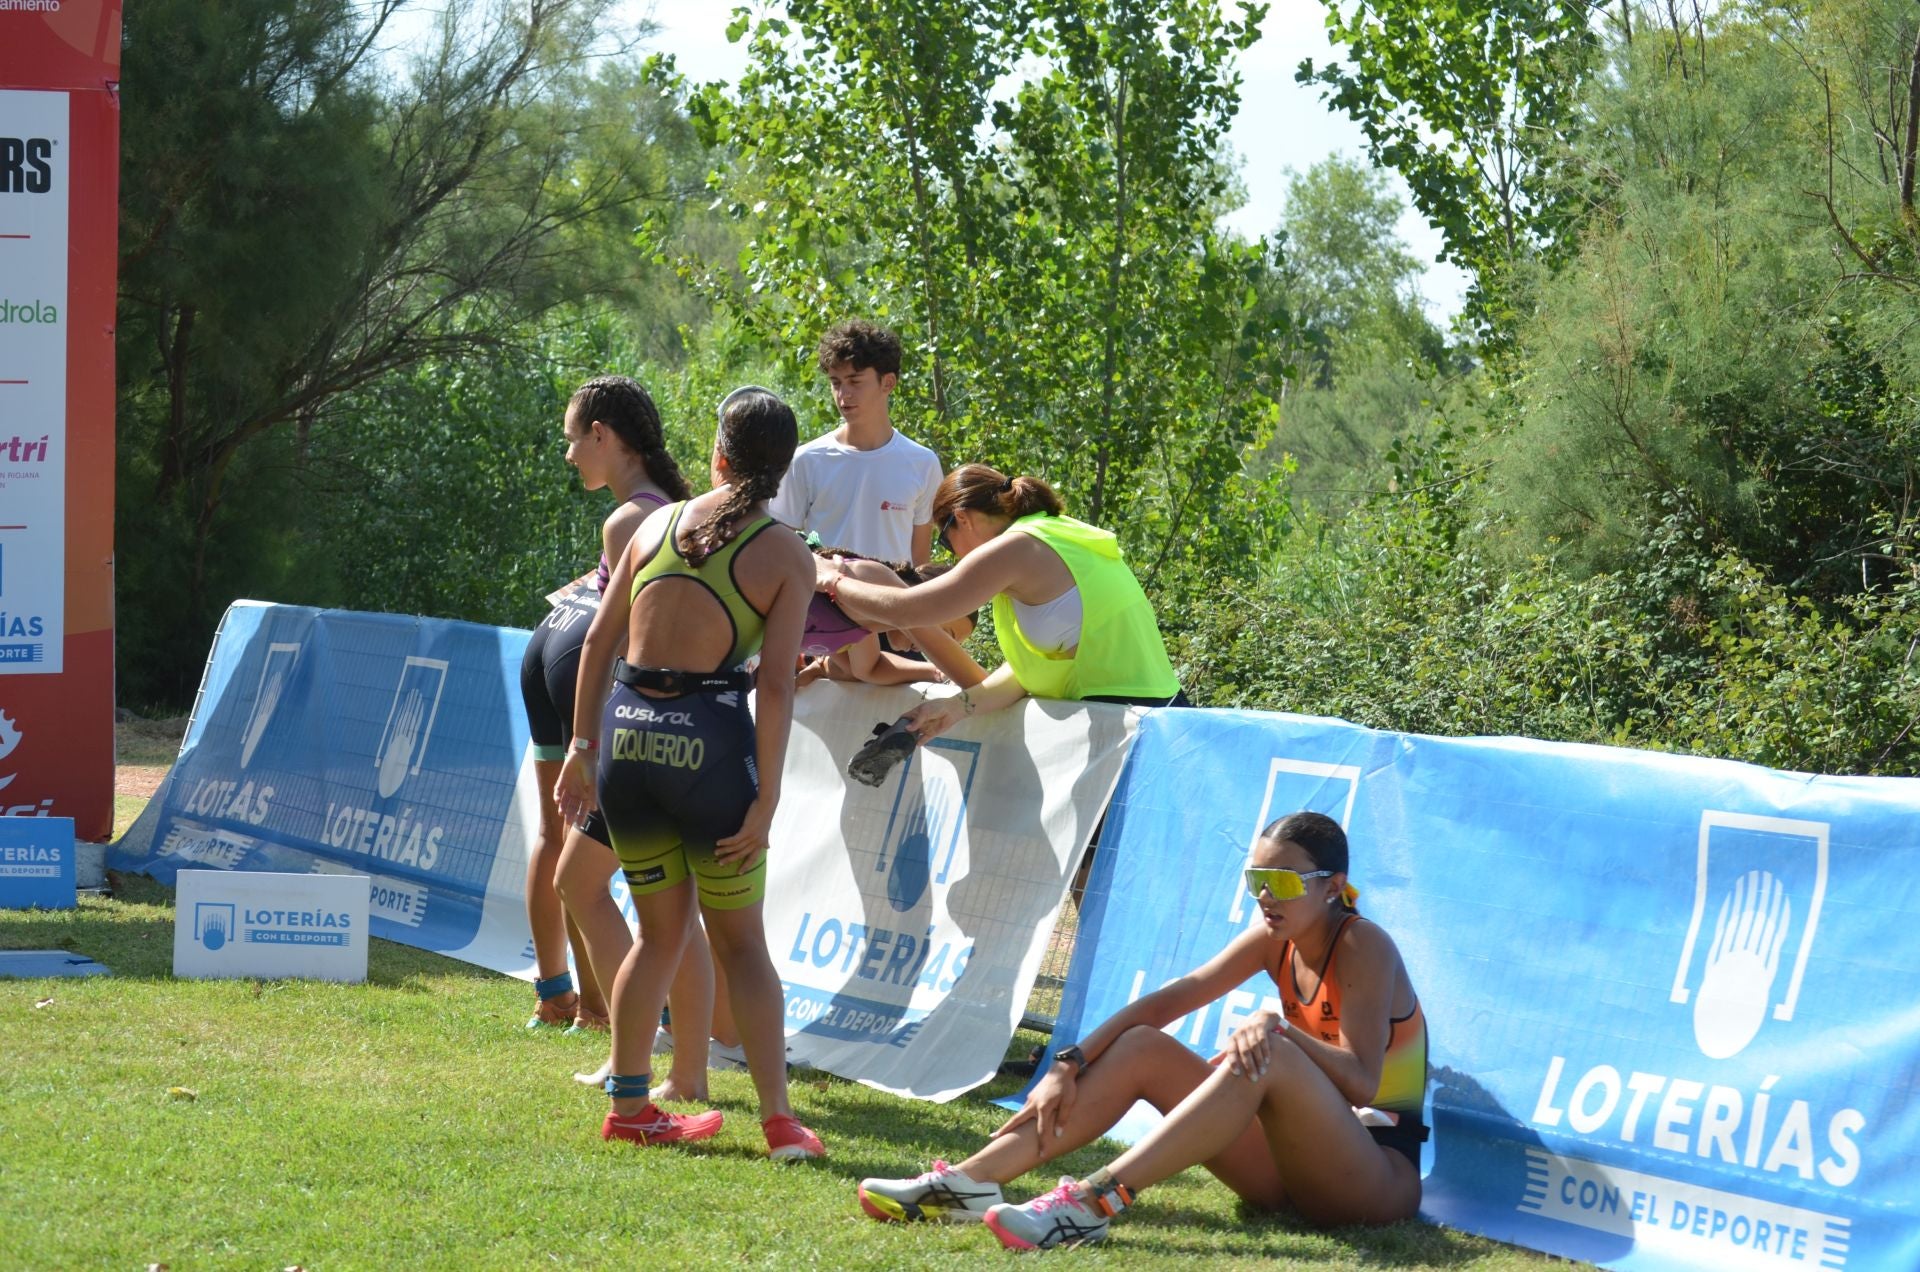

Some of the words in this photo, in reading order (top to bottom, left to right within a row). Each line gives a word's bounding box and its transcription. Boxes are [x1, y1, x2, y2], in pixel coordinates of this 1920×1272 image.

[540, 602, 588, 633] FONT
[612, 727, 705, 771] IZQUIERDO
[319, 801, 444, 871] LOTERÍAS
[368, 884, 411, 913] PORTE
[245, 908, 351, 928] LOTERÍAS
[256, 932, 278, 940] CON
[280, 933, 292, 941] EL
[293, 934, 339, 943] DEPORTE
[789, 912, 976, 993] LOTERÍAS
[786, 996, 823, 1021] CON
[820, 1005, 842, 1027] EL
[1532, 1055, 1867, 1188] LOTERÍAS
[1560, 1175, 1621, 1216] CON
[1628, 1190, 1660, 1226] EL
[1670, 1200, 1811, 1261] DEPORTE
